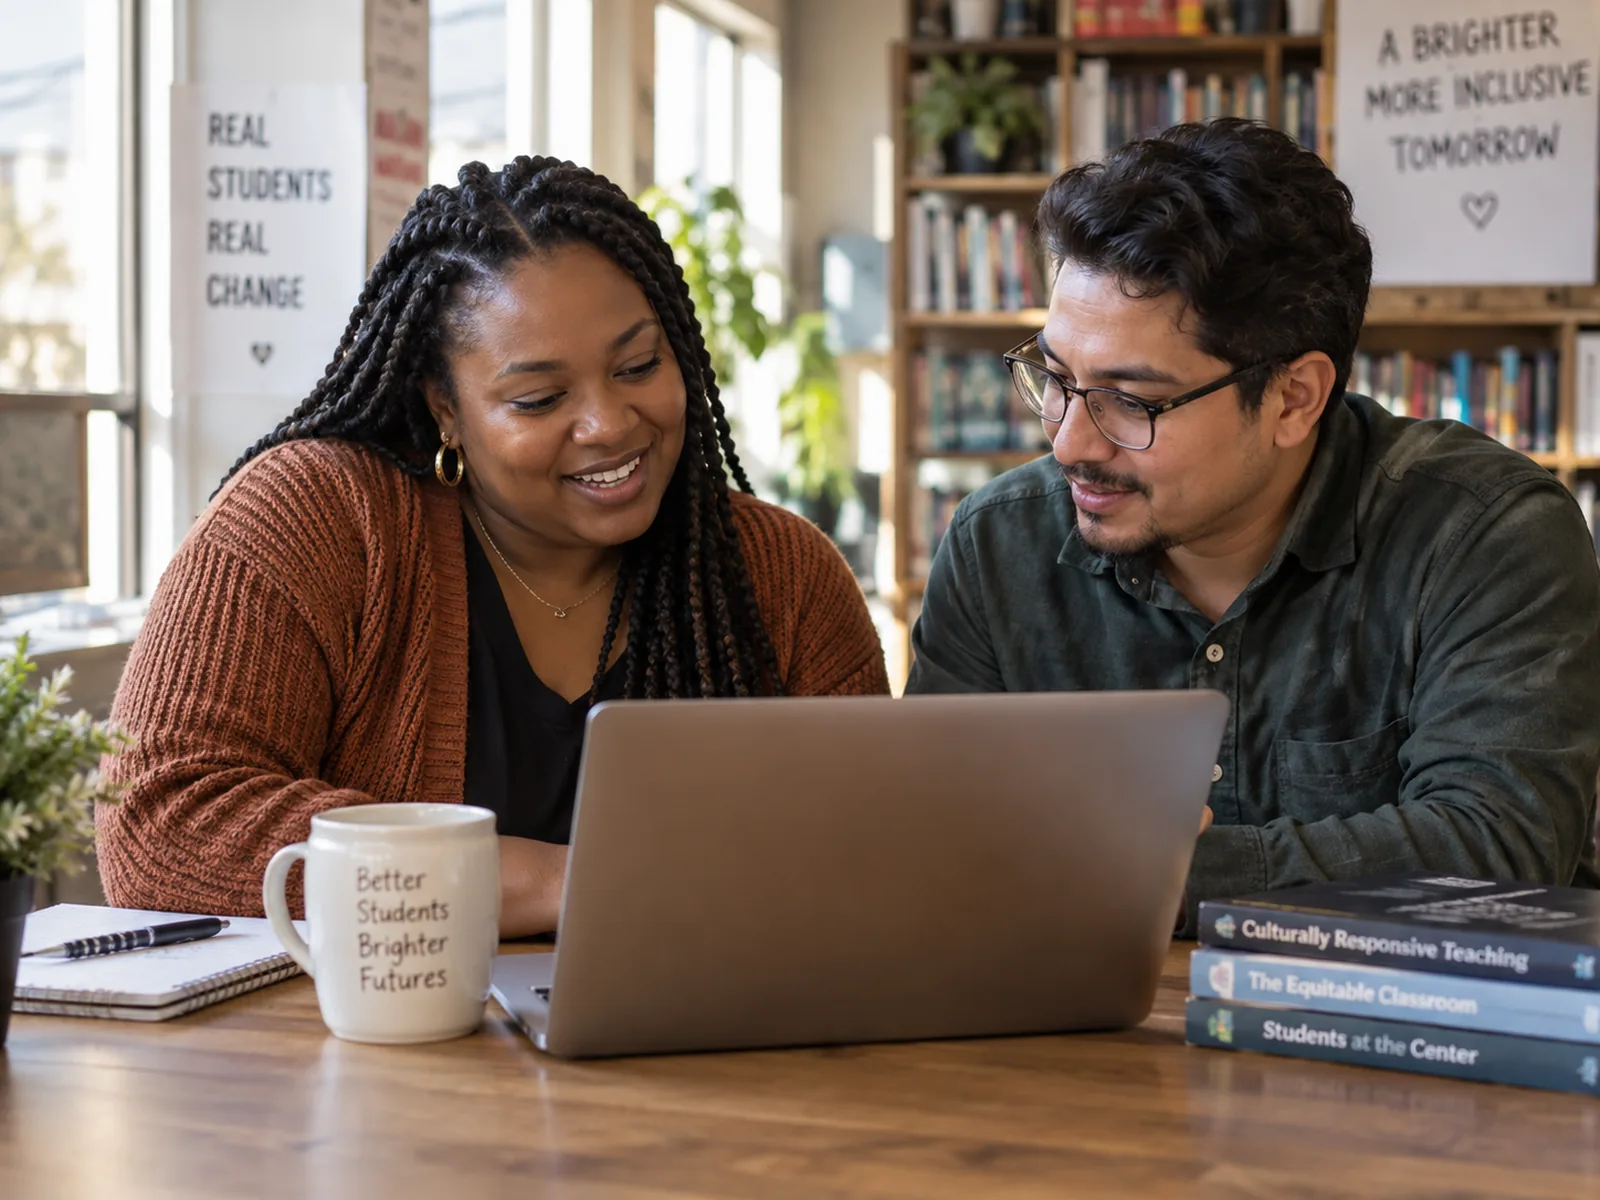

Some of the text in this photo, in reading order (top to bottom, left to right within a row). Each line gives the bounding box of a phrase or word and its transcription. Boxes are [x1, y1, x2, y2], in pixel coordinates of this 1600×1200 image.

[1378, 10, 1561, 65] A BRIGHTER
[1365, 59, 1592, 119] MORE INCLUSIVE
[207, 112, 270, 147] REAL
[1391, 122, 1561, 173] TOMORROW
[207, 166, 332, 202] STUDENTS
[207, 219, 269, 254] REAL
[207, 273, 304, 309] CHANGE
[356, 866, 427, 892] Better
[357, 899, 449, 925] Students
[358, 931, 449, 967] Brighter
[1241, 918, 1529, 975] Culturally Responsive Teaching
[360, 965, 447, 993] Futures
[1248, 970, 1478, 1015] The Equitable Classroom
[1262, 1019, 1479, 1066] Students at the Center
